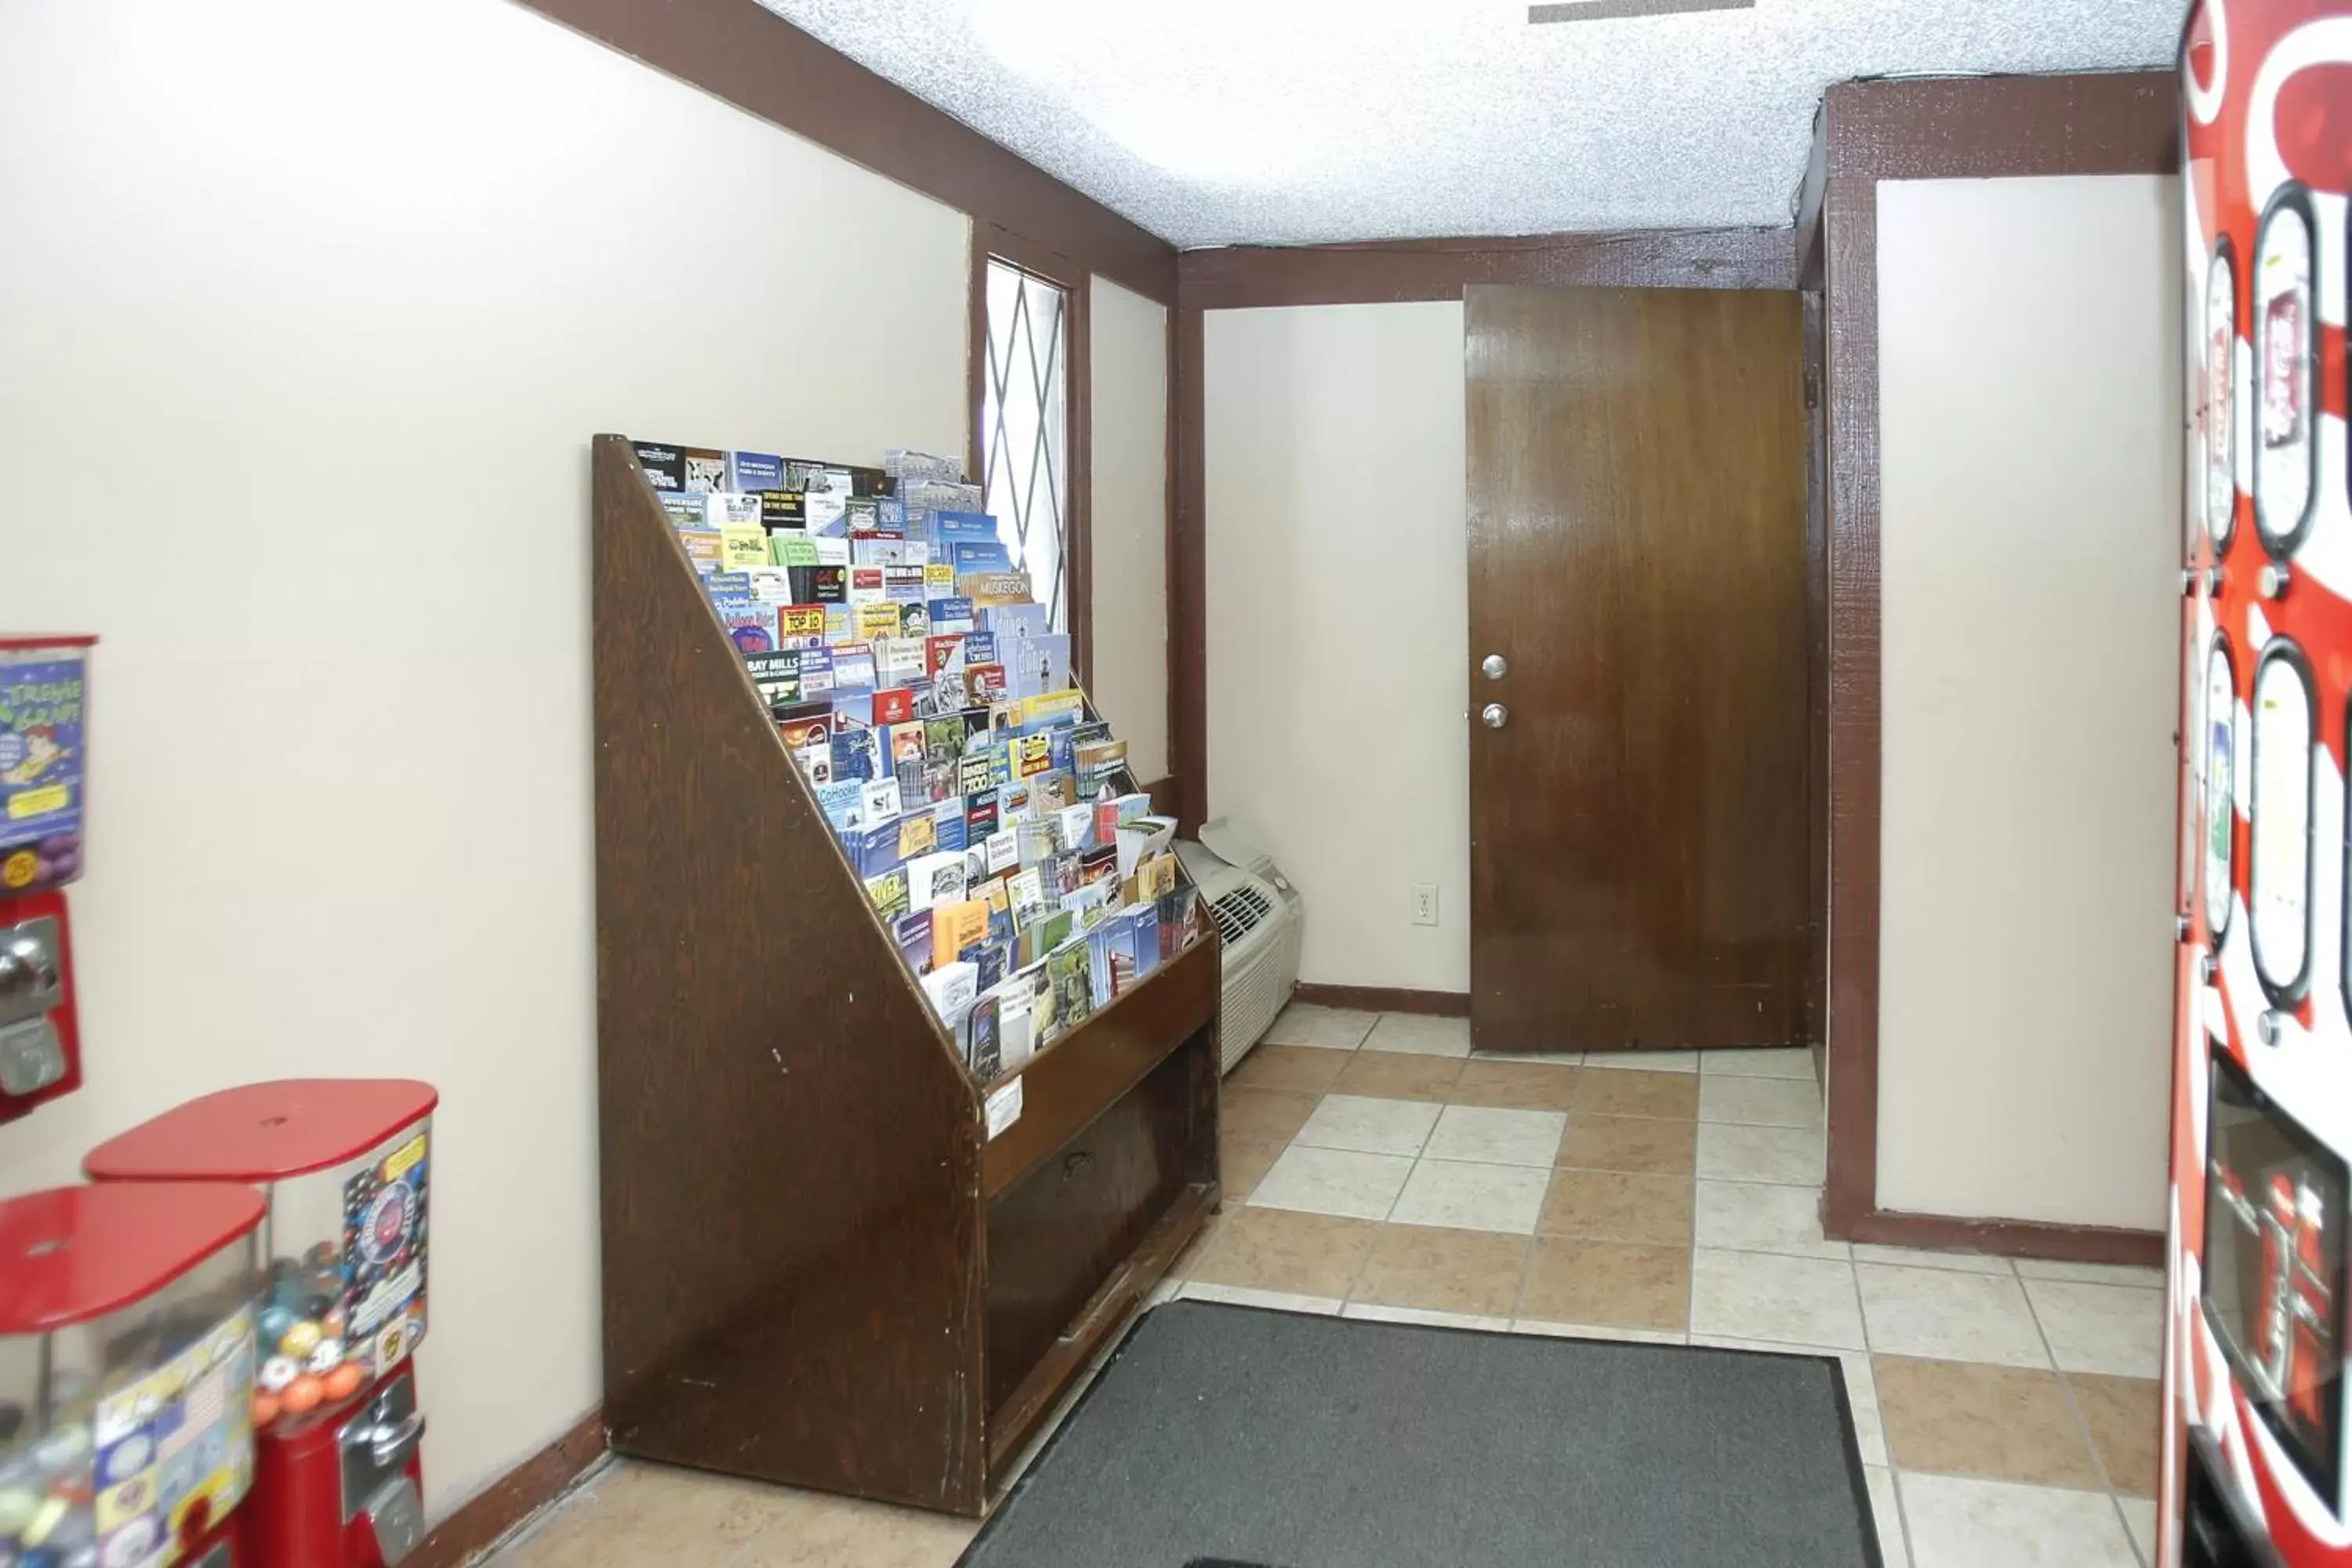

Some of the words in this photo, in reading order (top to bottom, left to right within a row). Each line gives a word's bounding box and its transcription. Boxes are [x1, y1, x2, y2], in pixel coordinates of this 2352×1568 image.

[981, 581, 1029, 594] MUSKEGON
[724, 612, 756, 627] Balloon
[788, 617, 807, 628] TOP
[809, 616, 819, 627] 10
[997, 612, 1029, 637] dunes
[746, 661, 768, 672] BAY
[769, 657, 800, 670] MILLS
[1018, 649, 1051, 674] dunes
